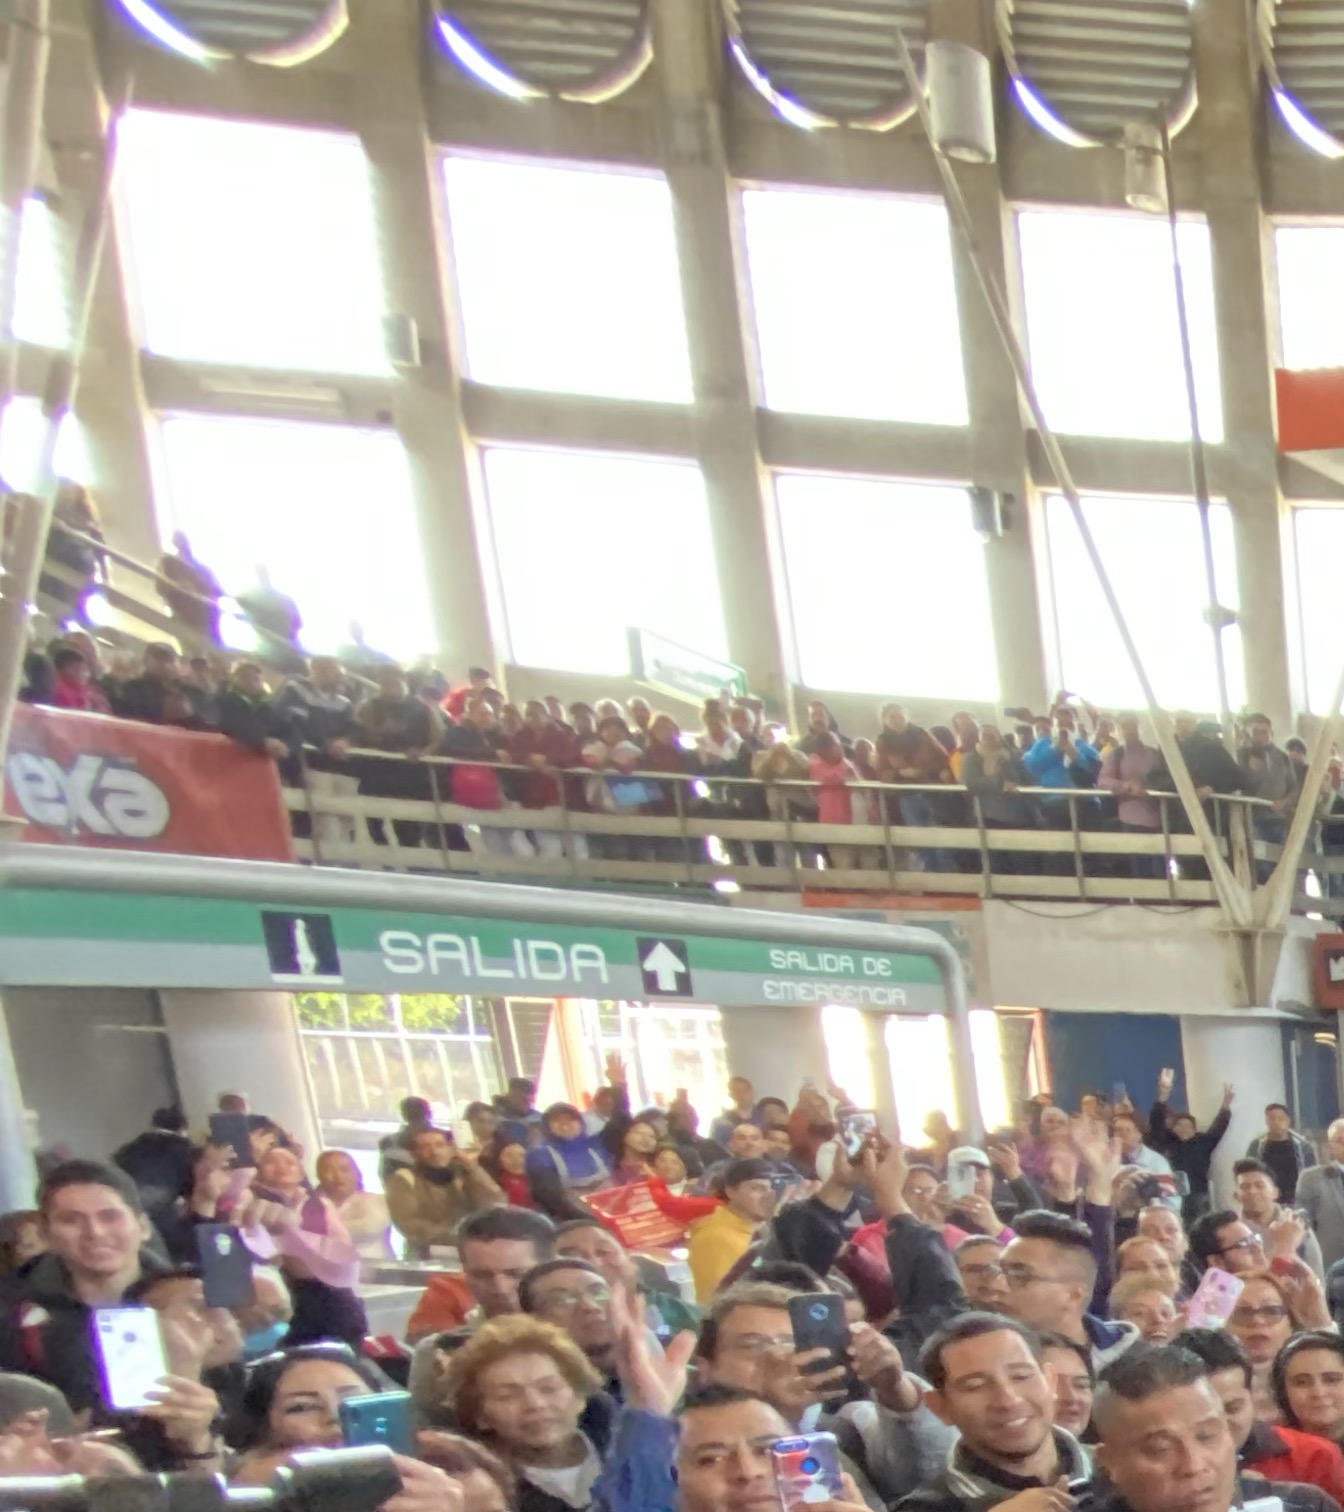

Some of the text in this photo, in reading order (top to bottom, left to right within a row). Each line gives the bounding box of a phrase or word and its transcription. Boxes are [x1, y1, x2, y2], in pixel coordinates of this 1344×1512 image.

[379, 930, 609, 984] SALIDA
[769, 949, 893, 976] SALIDA DE
[762, 979, 907, 1006] EMERGENCIA
